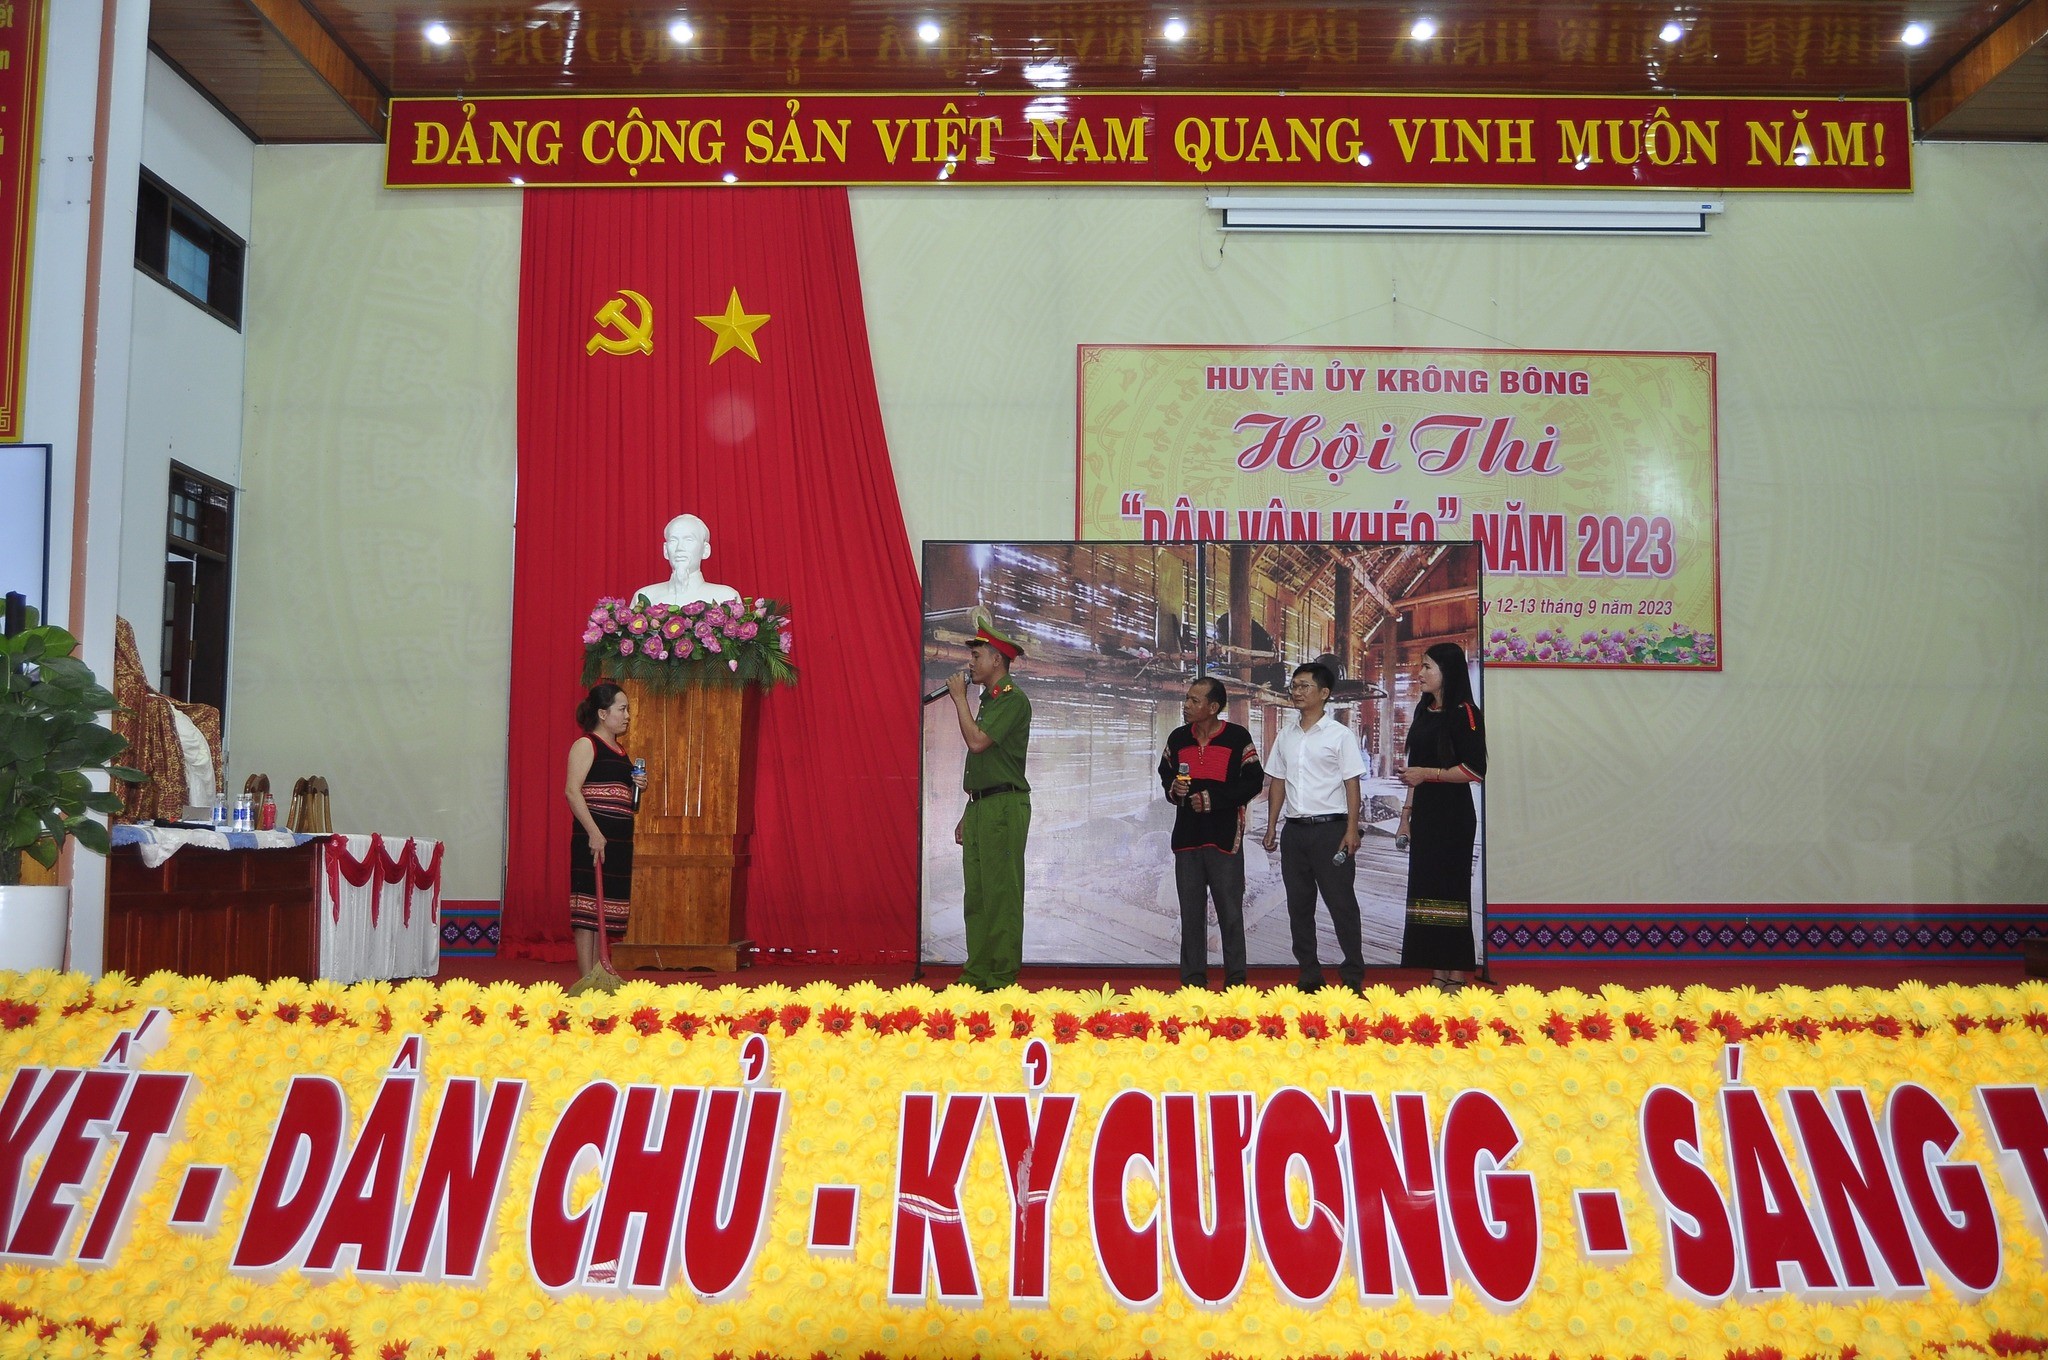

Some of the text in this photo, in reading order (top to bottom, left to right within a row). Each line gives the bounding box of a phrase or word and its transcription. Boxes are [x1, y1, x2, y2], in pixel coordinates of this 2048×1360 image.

[411, 99, 1887, 178] ĐẢNG CỘNG SẢN VIỆT NAM QUANG VINH MUÔN NĂM!
[1205, 360, 1590, 396] HUYỆN ỦY KRÔNG BÔNG
[1233, 412, 1565, 484] Hội Thi
[1472, 501, 1565, 573] NĂM
[1577, 515, 1673, 575] 2023
[1496, 598, 1536, 614] 12-13
[1540, 598, 1584, 618] tháng
[1587, 600, 1597, 615] 9
[1600, 600, 1633, 615] năm
[1637, 600, 1673, 615] 2023
[0, 1008, 192, 1262] KẾT
[229, 1035, 527, 1280] DÂN
[528, 1033, 787, 1297] CHỦ
[887, 1037, 1080, 1302] KỶ
[1088, 1086, 1542, 1305] CƯƠNG
[1640, 1043, 2002, 1300] SÁNG
